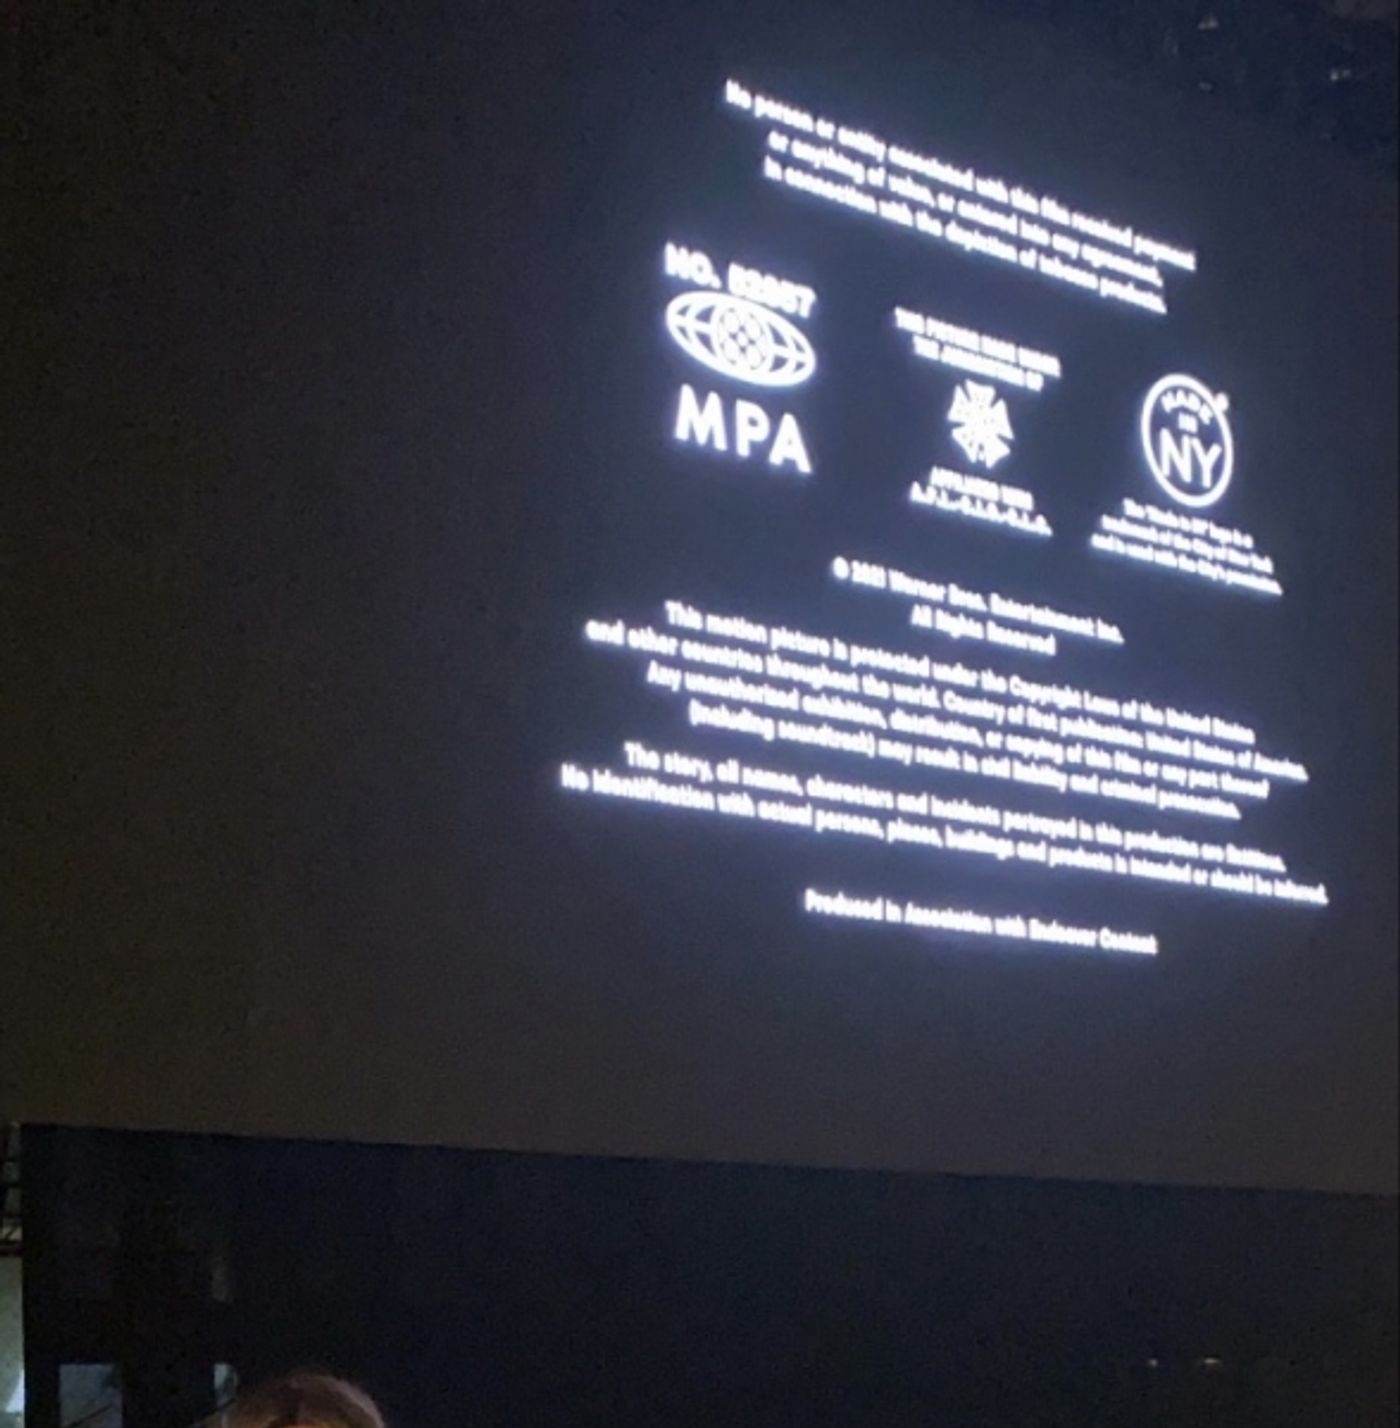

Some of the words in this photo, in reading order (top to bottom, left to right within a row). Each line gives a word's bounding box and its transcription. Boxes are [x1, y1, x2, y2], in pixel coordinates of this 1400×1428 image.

[676, 385, 811, 472] MPA
[1160, 427, 1222, 488] NY
[888, 570, 947, 601] Warner
[1009, 675, 1082, 710] Copyright
